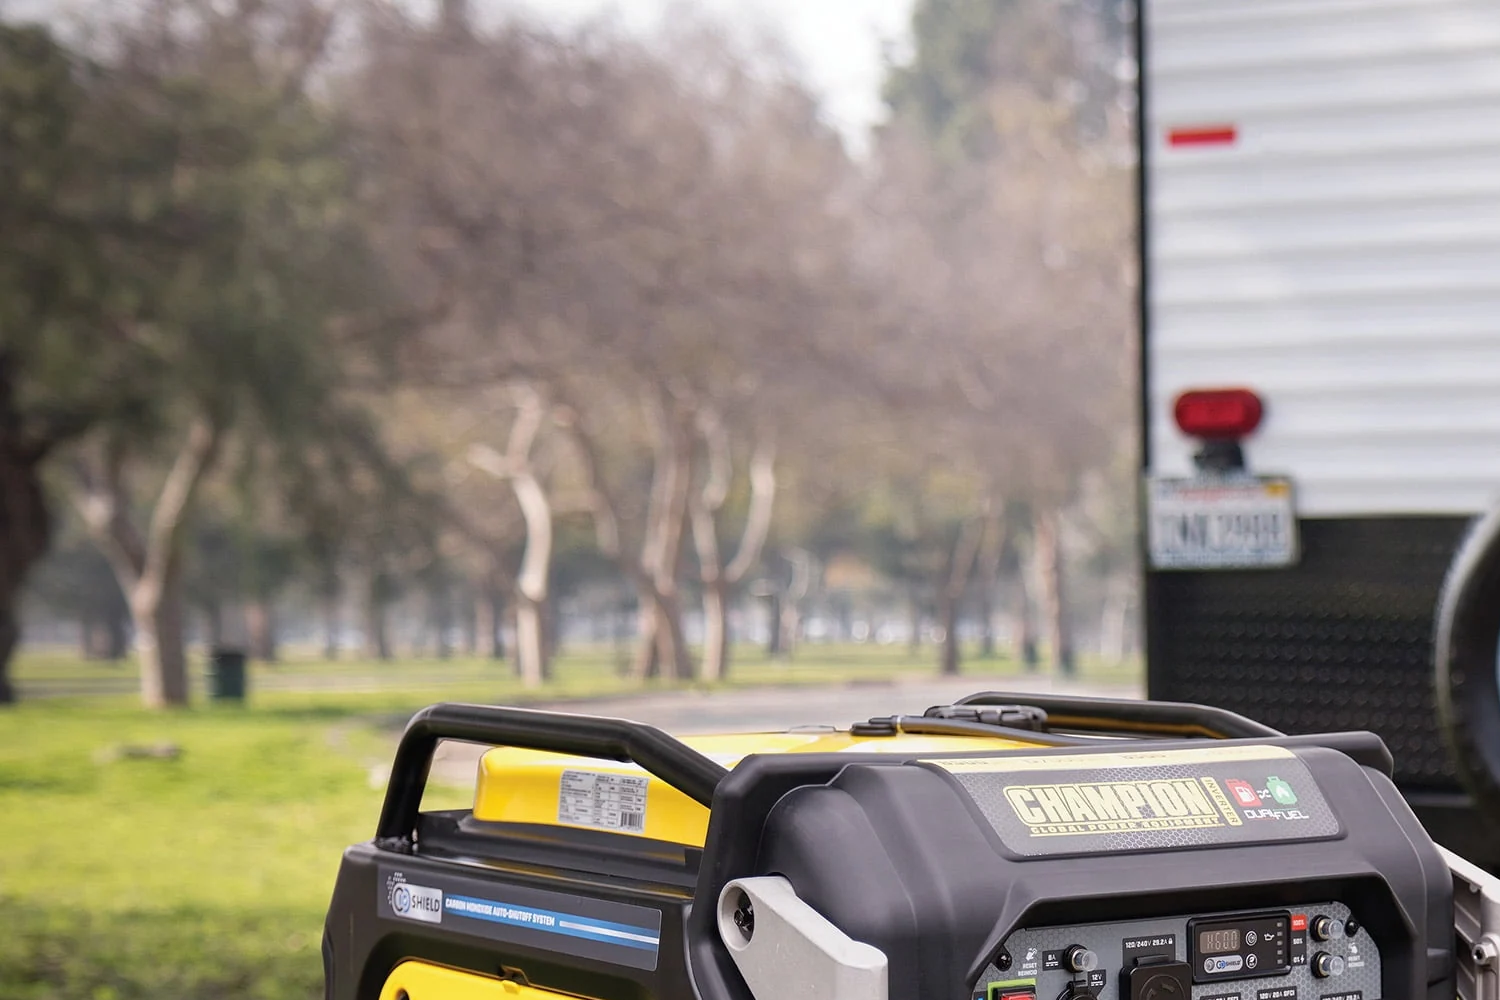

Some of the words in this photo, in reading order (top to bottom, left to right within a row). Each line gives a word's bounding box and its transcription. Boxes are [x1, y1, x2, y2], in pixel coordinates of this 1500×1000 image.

[1006, 781, 1216, 824] CHAMPION
[1204, 779, 1239, 823] INVERTER
[1031, 824, 1080, 835] GLOBAL
[1090, 821, 1136, 831] POWER
[1141, 817, 1219, 829] EQUIPMENT
[412, 895, 440, 913] SHIELD
[445, 898, 466, 910] CARBON
[466, 901, 493, 915] MONOXIDE
[493, 906, 532, 922] AUTO-SHUTOFF
[532, 913, 555, 926] SYSTEM
